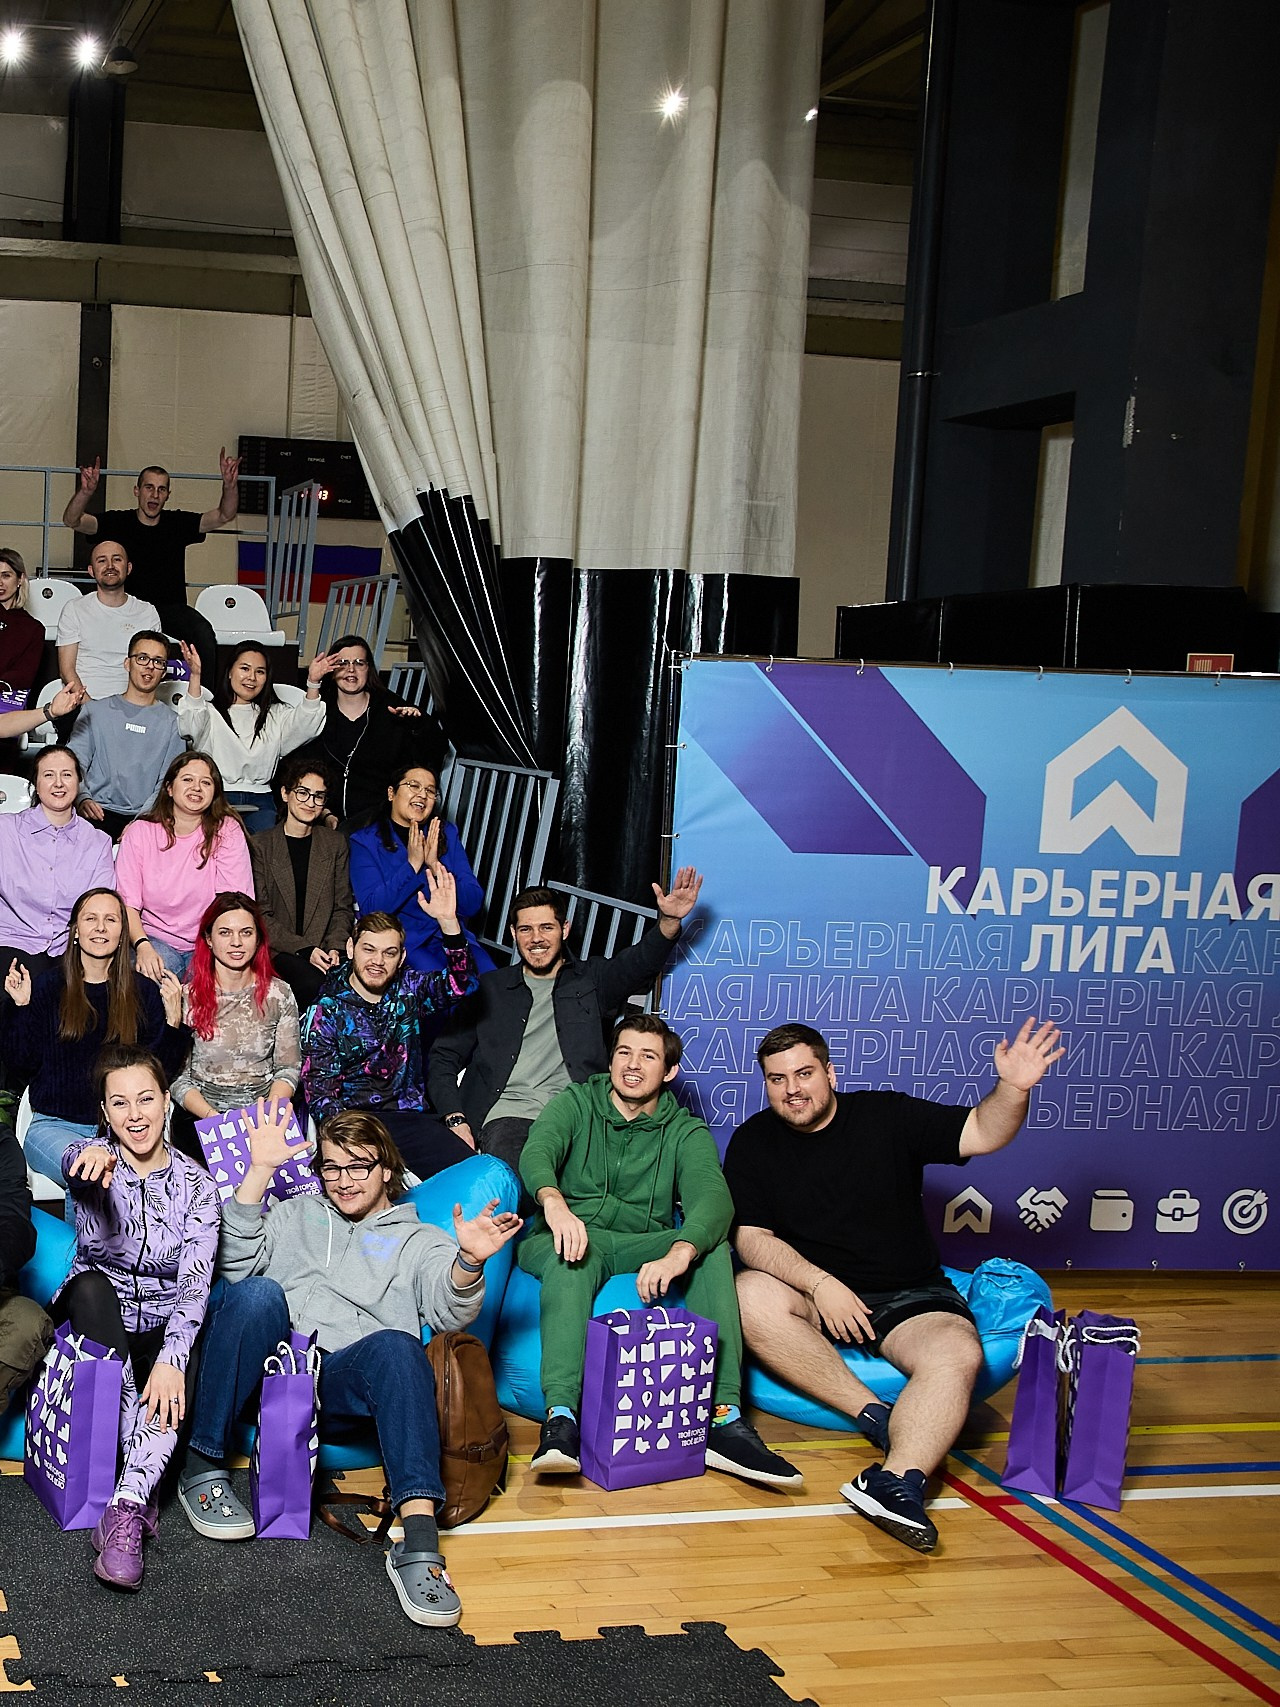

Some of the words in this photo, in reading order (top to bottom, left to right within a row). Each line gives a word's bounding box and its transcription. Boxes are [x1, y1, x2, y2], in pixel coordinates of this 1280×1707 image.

[925, 866, 1280, 921] КАРЬЕРНАЯ
[665, 918, 1014, 972] КАРЬЕРНАЯ
[1020, 924, 1176, 974] ЛИГА
[660, 974, 753, 1021] АЯ
[759, 973, 911, 1022] ЛИГА
[921, 976, 1264, 1028] КАРЬЕРНАЯ
[666, 1026, 1006, 1077] КАРЕРНАЯ
